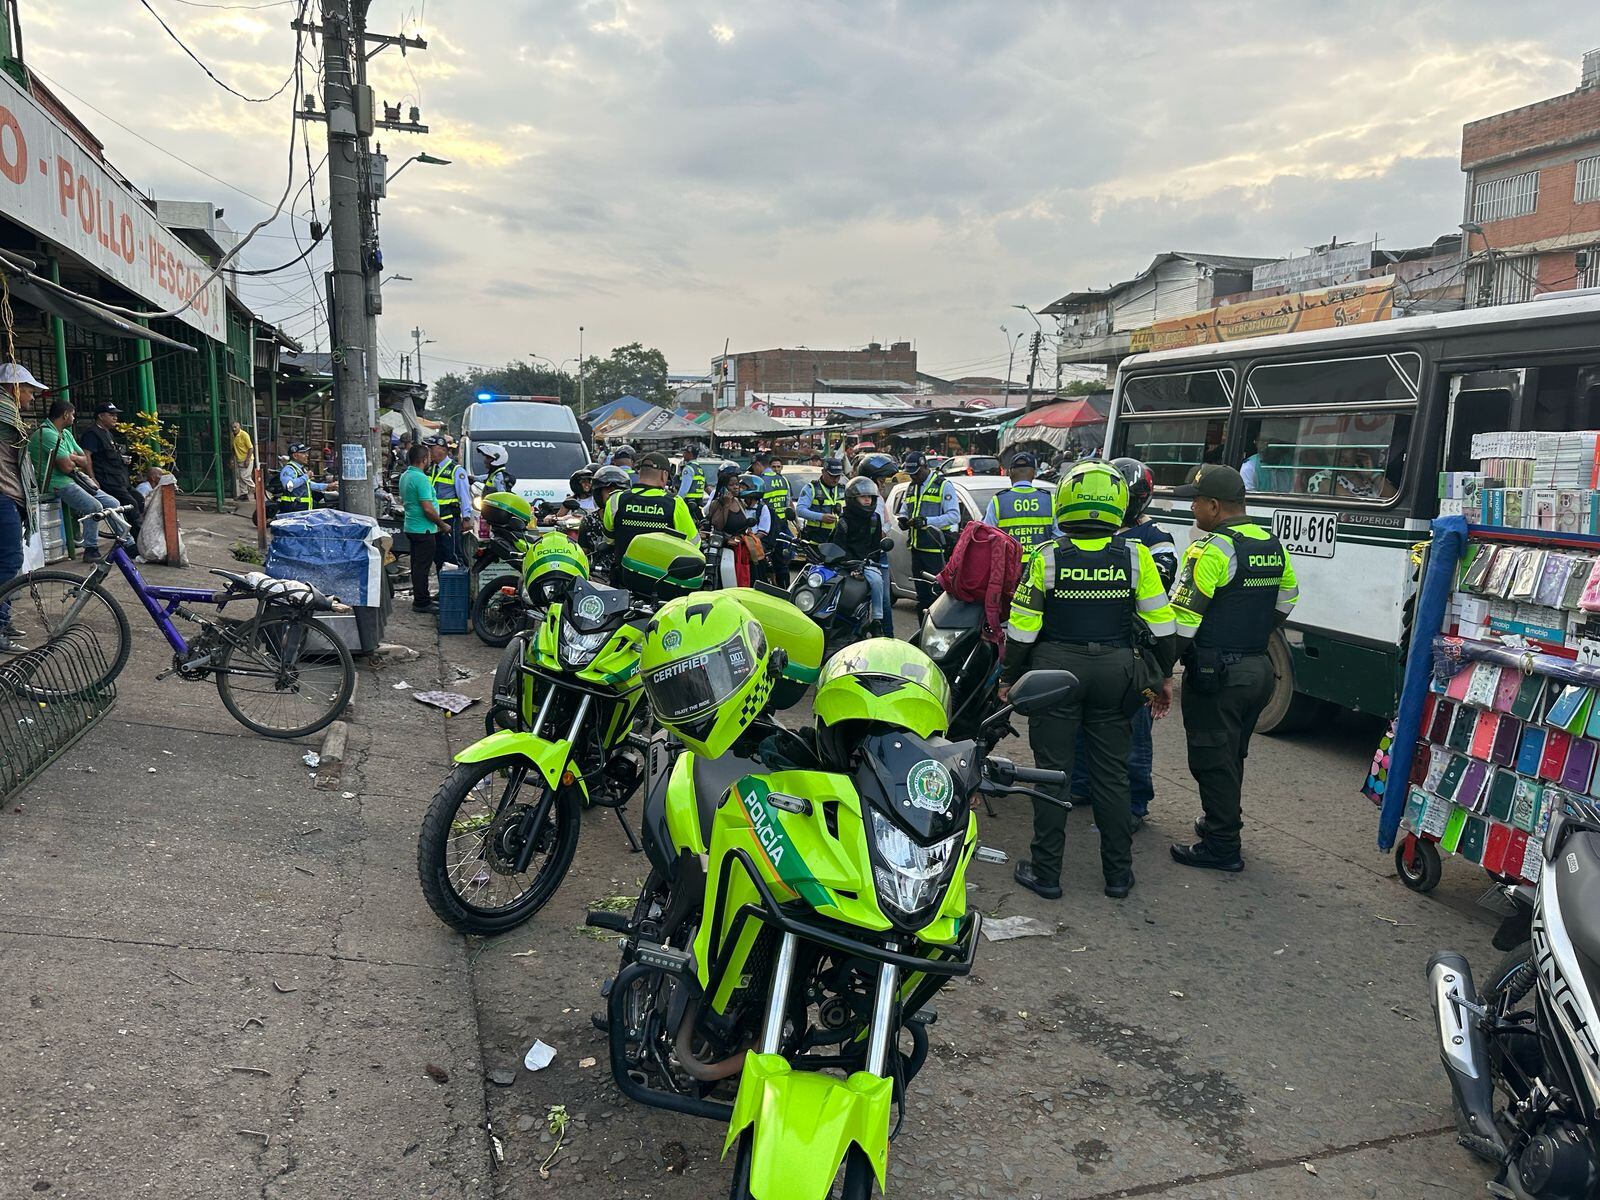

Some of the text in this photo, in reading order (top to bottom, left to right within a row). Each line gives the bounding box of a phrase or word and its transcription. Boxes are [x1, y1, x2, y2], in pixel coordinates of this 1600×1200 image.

[57, 154, 135, 264] POLLO
[148, 232, 209, 317] PESCADO
[781, 407, 797, 418] La
[498, 441, 556, 449] POLICIA
[770, 479, 783, 488] 441
[523, 489, 555, 497] 27-3350
[1077, 493, 1114, 502] POLICÍA
[625, 503, 665, 516] POLICÍA
[1013, 498, 1040, 512] 605
[1349, 515, 1400, 527] SUPERIOR
[1008, 527, 1045, 536] AGENTE
[1276, 514, 1335, 544] VBU 616
[1020, 536, 1032, 544] DE
[537, 547, 572, 557] POLICÍA
[1286, 543, 1317, 554] CALI
[1248, 552, 1284, 567] POLICÍA
[1060, 564, 1127, 581] POLICÍA
[729, 651, 744, 662] DOT
[653, 654, 709, 684] CERTIFIED
[674, 699, 711, 716] ENJOY THE RIDE
[744, 790, 784, 867] POLICÍA
